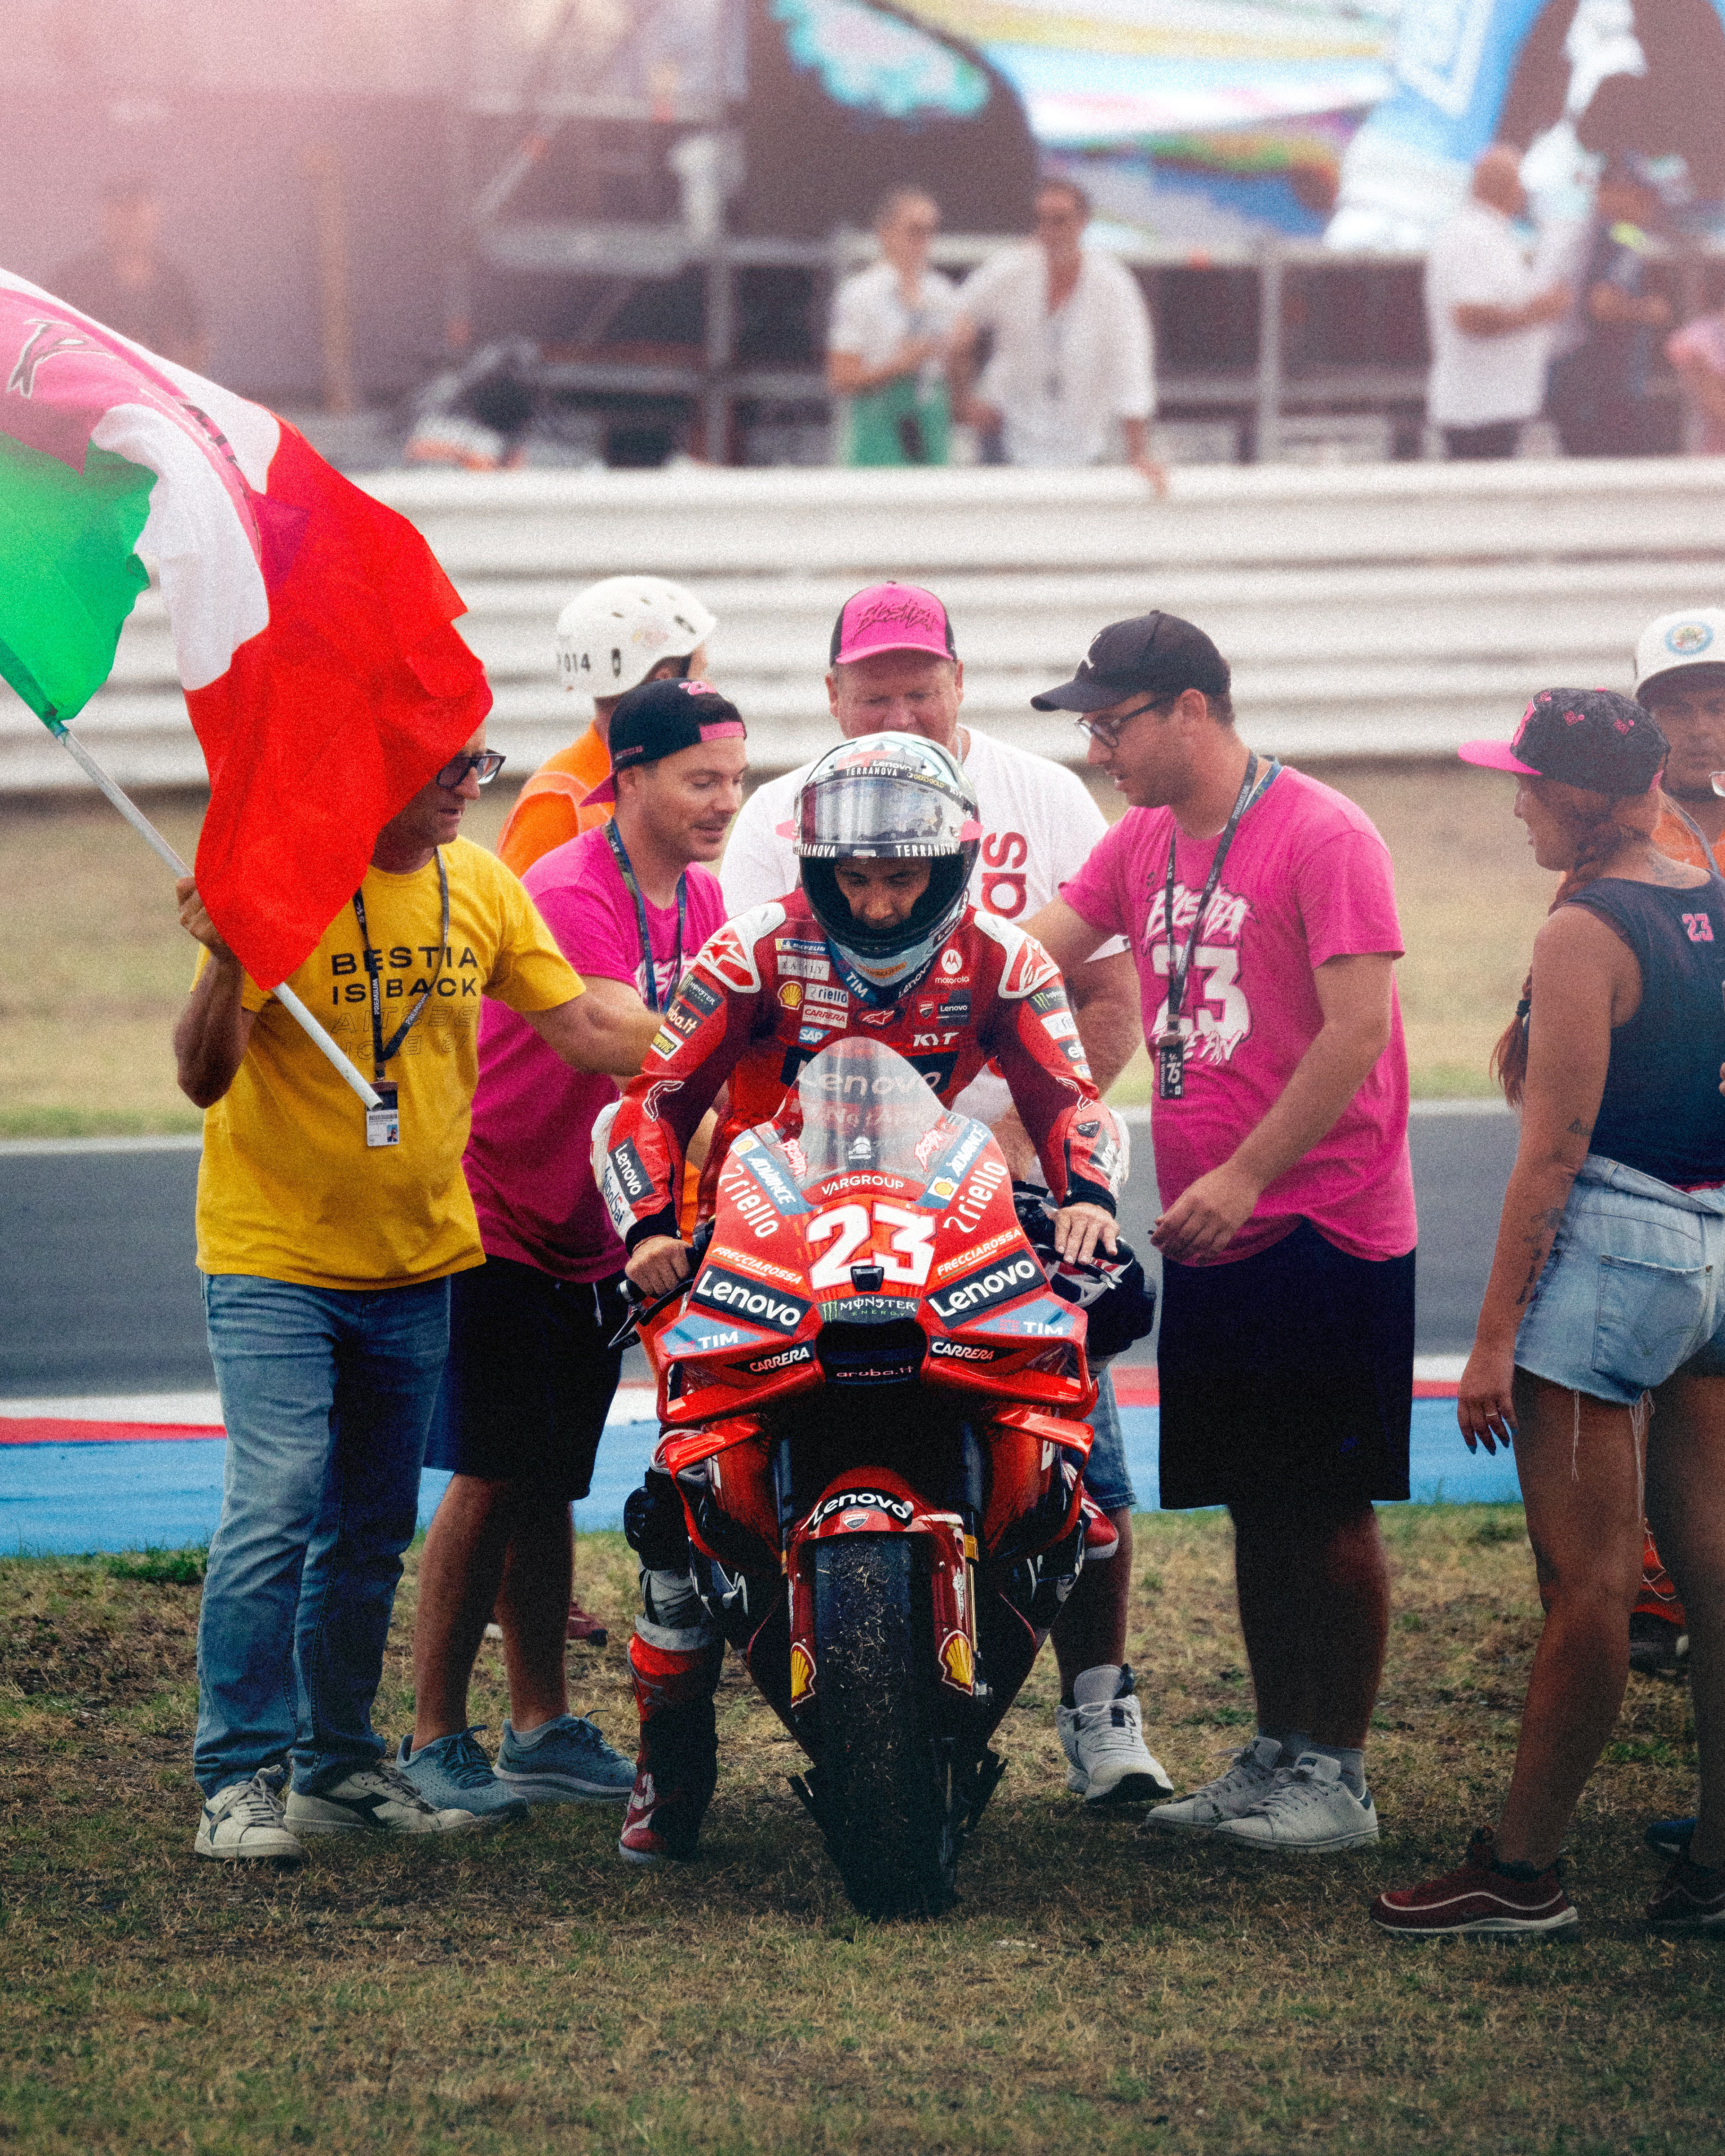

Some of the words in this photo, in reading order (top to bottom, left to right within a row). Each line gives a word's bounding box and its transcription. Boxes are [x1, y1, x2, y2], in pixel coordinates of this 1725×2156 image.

[846, 766, 897, 777] TERRANOVA
[873, 760, 912, 771] Lenovo
[929, 778, 944, 788] GOLD
[895, 844, 955, 857] TERRANOVA
[1682, 913, 1714, 942] 23
[793, 943, 826, 951] MICHELIN
[331, 946, 478, 976] BESTIA
[783, 962, 824, 973] EATALY
[332, 984, 367, 1005] IS
[386, 978, 478, 998] BACK
[846, 971, 868, 998] TIM
[898, 960, 931, 998] Lenovo
[1152, 944, 1250, 1039] 23
[690, 982, 715, 1005] MONSTER
[818, 989, 848, 1003] riello
[405, 993, 429, 1025] PREMIUM
[805, 1009, 845, 1022] CARRERA
[799, 1029, 824, 1043] SAP
[913, 1032, 960, 1047] KYT
[951, 1125, 988, 1177] ADVANCE
[615, 1144, 641, 1195] Lenovo
[748, 1158, 798, 1206] ADVANCE
[822, 1175, 904, 1196] VARGROUP
[805, 1201, 937, 1290] 23
[937, 1228, 1022, 1276] FRECCIAROSSA
[711, 1246, 803, 1285] FRECCIAROSSA
[696, 1270, 801, 1326] Lenovo
[929, 1259, 1035, 1317] Lenovo
[840, 1297, 917, 1312] MONSTER
[699, 1331, 739, 1349] TIM
[1023, 1321, 1063, 1335] TIM
[749, 1347, 810, 1372] CARRERA
[932, 1341, 994, 1361] CARRERA
[801, 1493, 912, 1530] Lenovo
